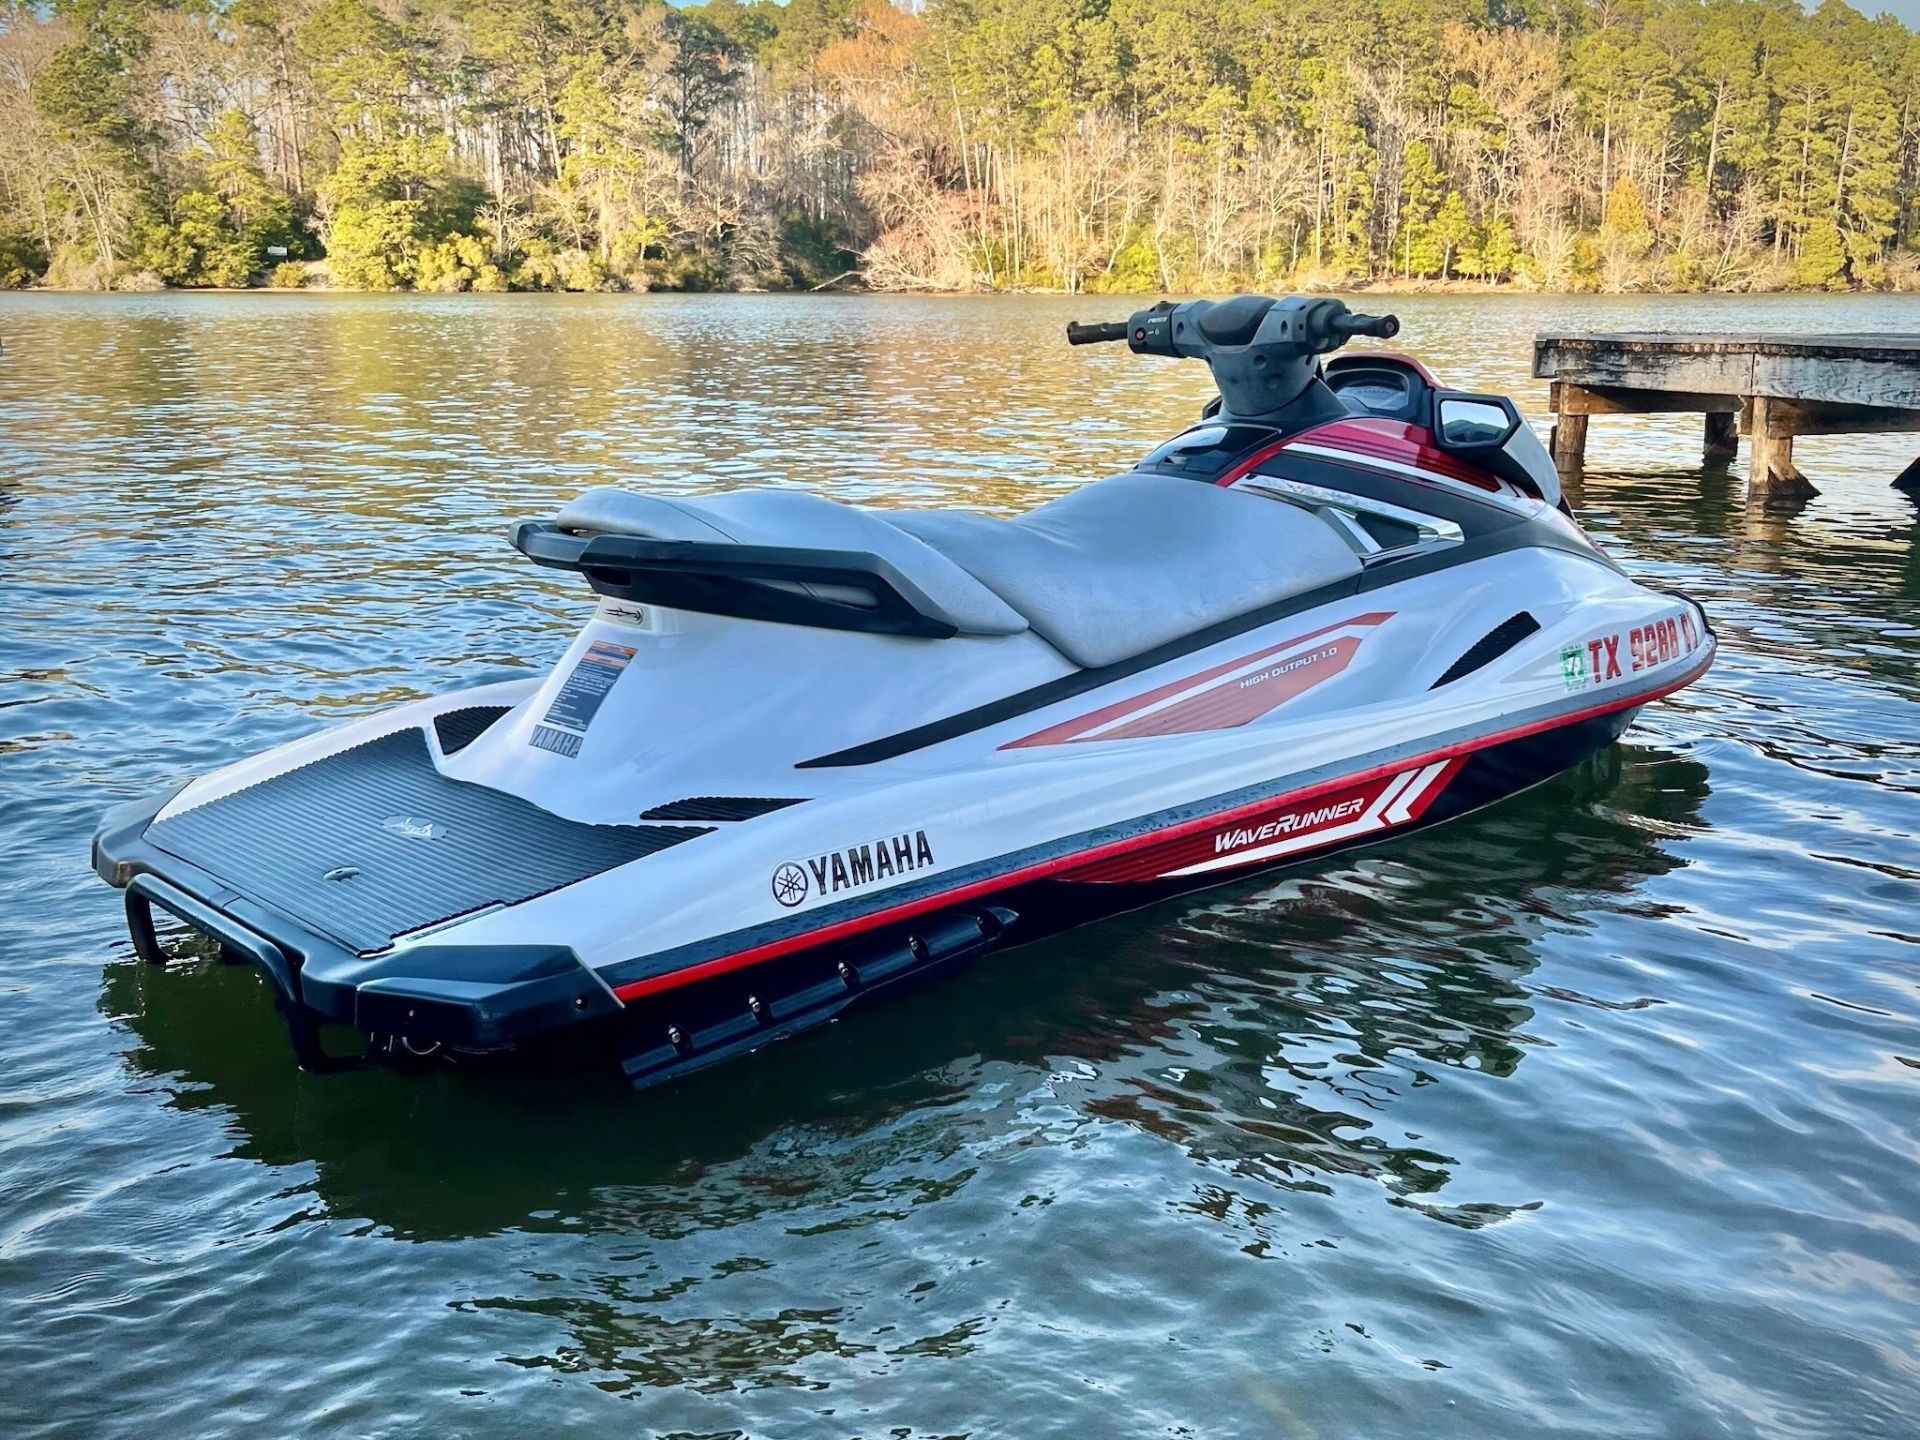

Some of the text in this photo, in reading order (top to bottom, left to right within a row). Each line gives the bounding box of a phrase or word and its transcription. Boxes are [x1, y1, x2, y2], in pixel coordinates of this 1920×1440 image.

[1240, 646, 1338, 689] HIGH OUTPUT 1.0
[1588, 634, 1622, 683] TX
[529, 724, 584, 759] YAMAHA
[807, 830, 935, 896] YAMAHA
